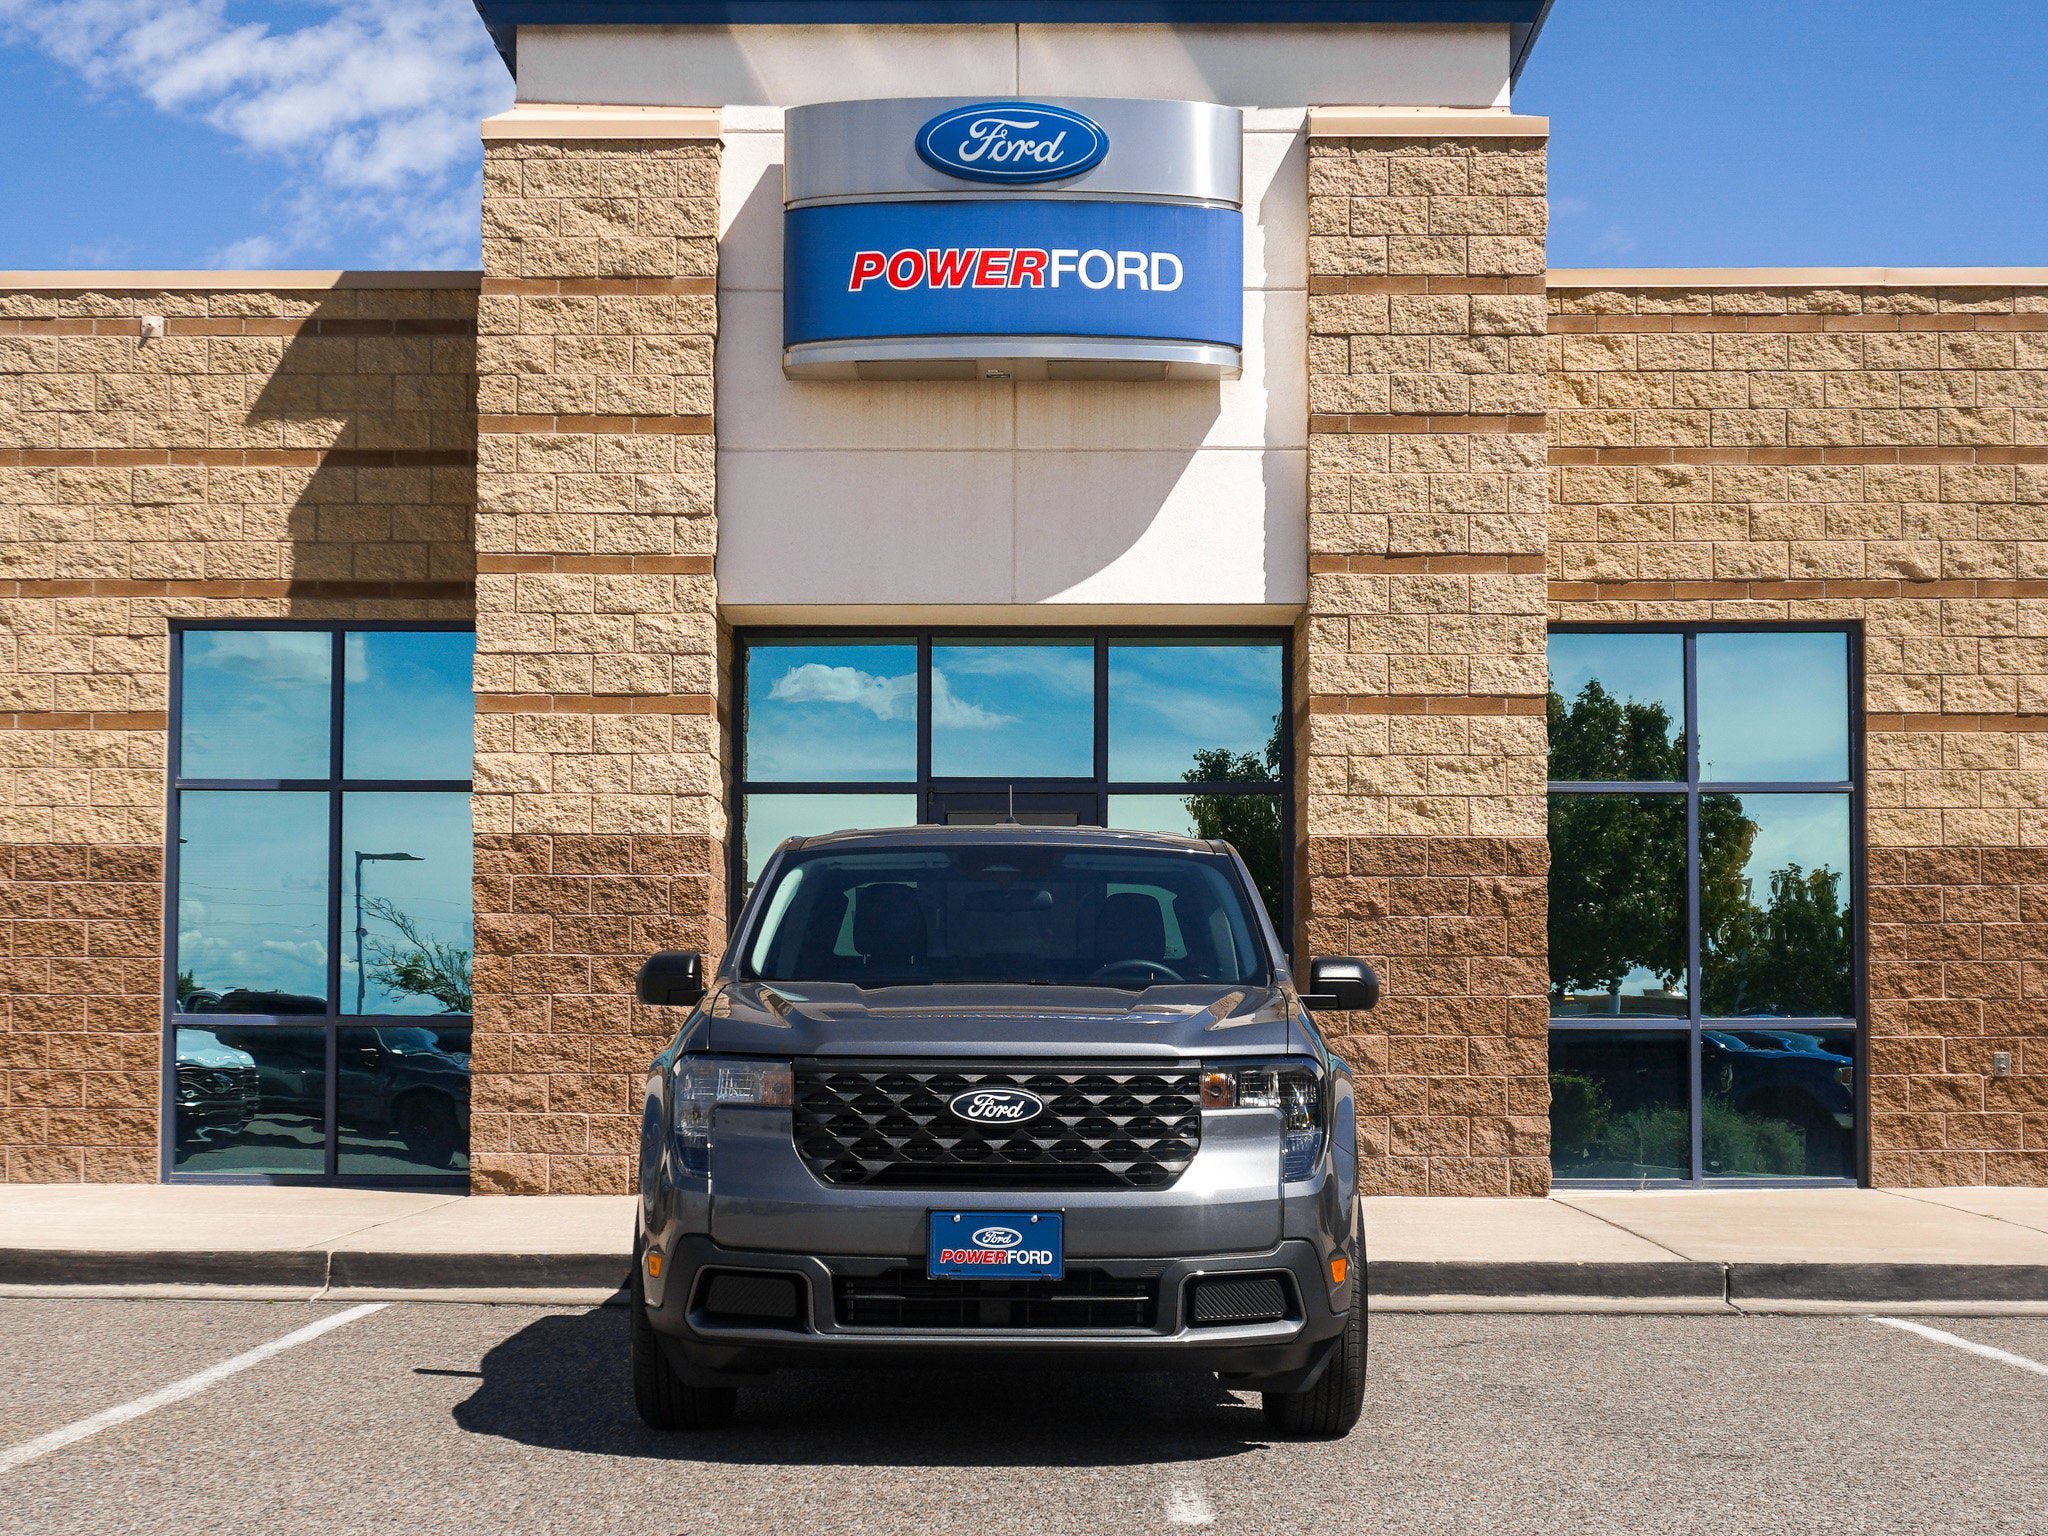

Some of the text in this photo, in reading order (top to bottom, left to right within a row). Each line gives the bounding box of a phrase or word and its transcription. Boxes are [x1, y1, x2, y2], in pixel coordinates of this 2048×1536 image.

[958, 118, 1065, 163] Ford
[848, 248, 1184, 291] POWERFORD
[967, 1094, 1025, 1118] Ford
[982, 1231, 1012, 1244] Ford
[940, 1249, 1053, 1265] POWERFORD
